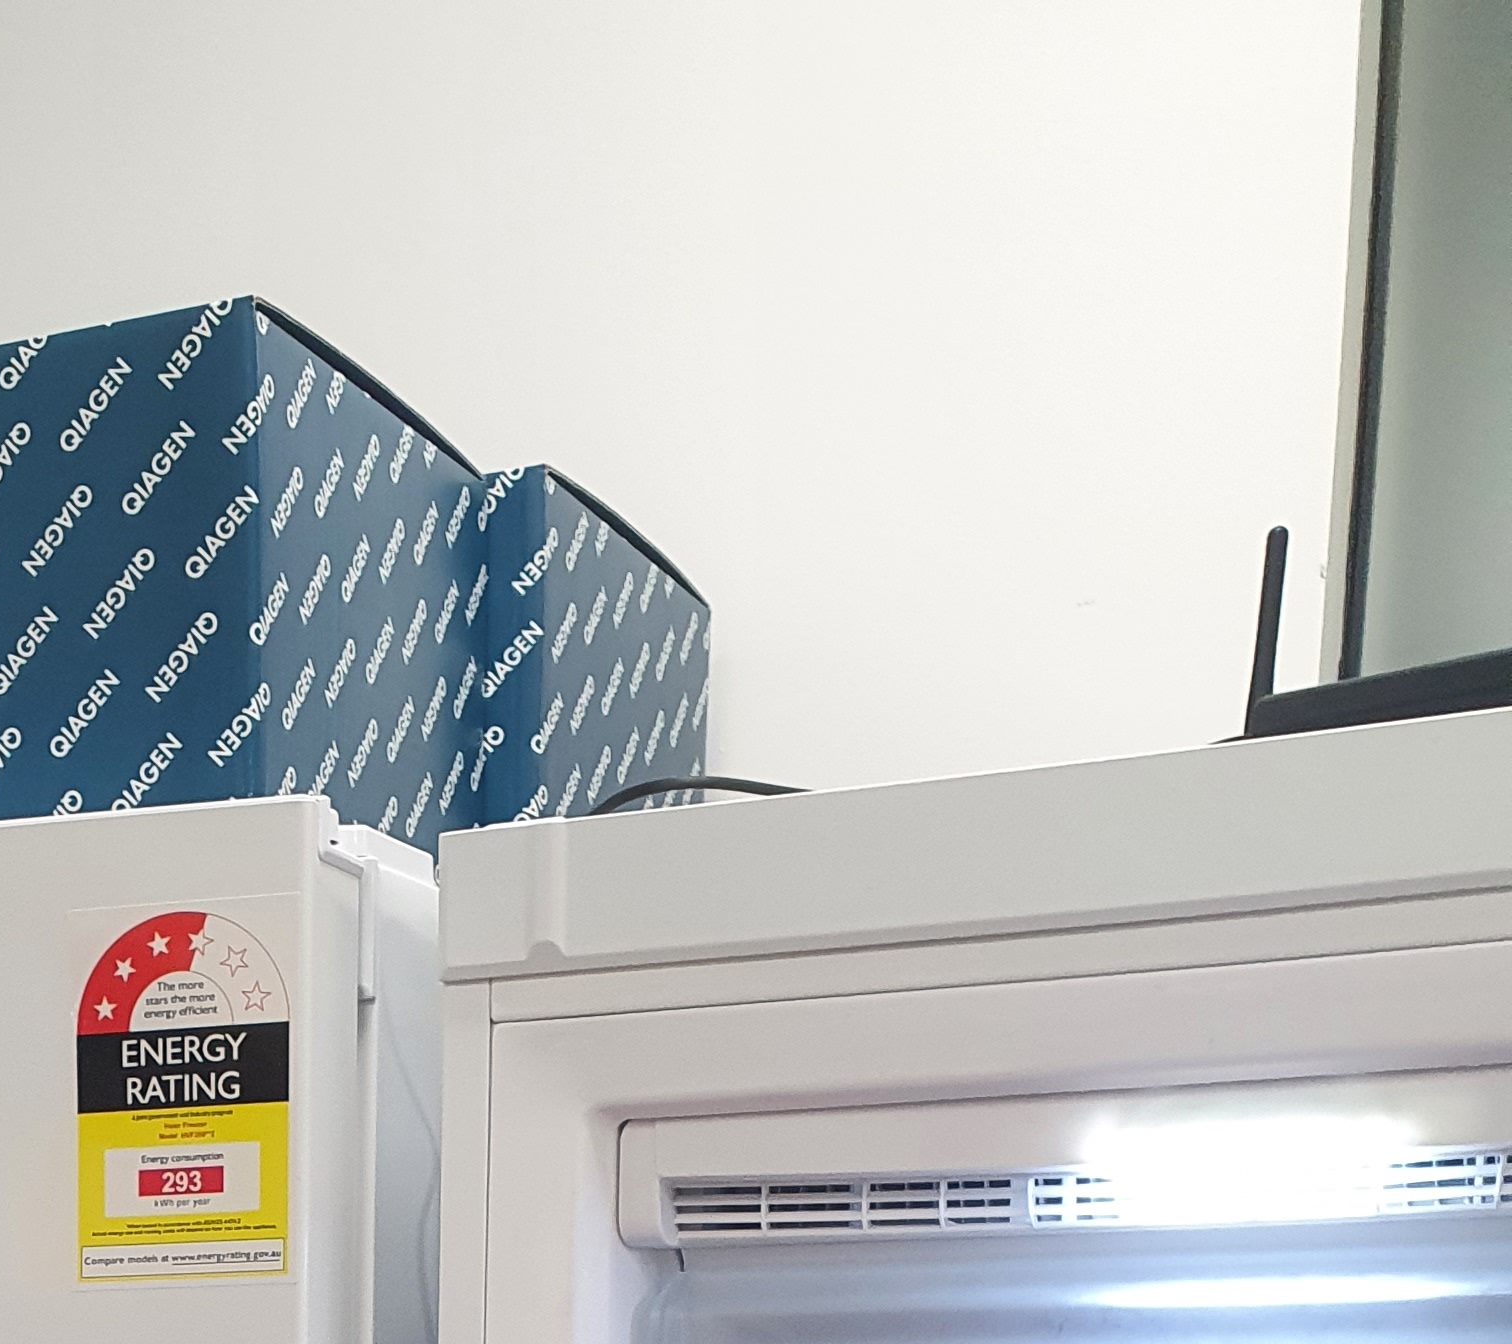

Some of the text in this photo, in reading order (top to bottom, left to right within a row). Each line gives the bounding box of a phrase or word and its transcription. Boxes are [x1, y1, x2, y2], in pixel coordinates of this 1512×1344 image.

[158, 299, 233, 390] QIAGEN
[60, 357, 132, 451] QIAGEN
[222, 374, 274, 455] QIAGEN
[287, 358, 316, 428] QIAGEN
[122, 421, 195, 514] QIAGEN
[315, 448, 344, 518] QIAGEN
[353, 434, 379, 501] QIAGEN
[22, 485, 92, 576] QIAGEN
[185, 485, 255, 578] QIAGEN
[271, 467, 303, 538] QIAGEN
[414, 501, 438, 565] QIAGEN
[342, 534, 370, 602] QIAGEN
[379, 519, 404, 584] QIAGEN
[512, 527, 558, 596] QIAGEN
[83, 549, 154, 639] QIAGEN
[249, 573, 289, 645] QIAGEN
[299, 554, 330, 625] QIAGEN
[145, 613, 217, 702] QIAGEN
[366, 617, 394, 684] QIAGEN
[402, 599, 426, 664] QIAGEN
[481, 621, 543, 698] QIAGEN
[282, 658, 315, 730] QIAGEN
[325, 639, 355, 708] QIAGEN
[50, 669, 120, 757] QIAGEN
[208, 683, 270, 767] QIAGEN
[387, 696, 414, 763] QIAGEN
[421, 677, 446, 741] QIAGEN
[144, 1006, 218, 1020] energy efficient
[145, 994, 215, 1006] stars the more
[157, 981, 204, 992] The more
[121, 1032, 247, 1068] ENERGY
[126, 1071, 241, 1105] RATING
[141, 1152, 224, 1165] Energy consumption
[162, 1170, 202, 1193] 293
[84, 1255, 125, 1267] Compare
[128, 1254, 158, 1263] models
